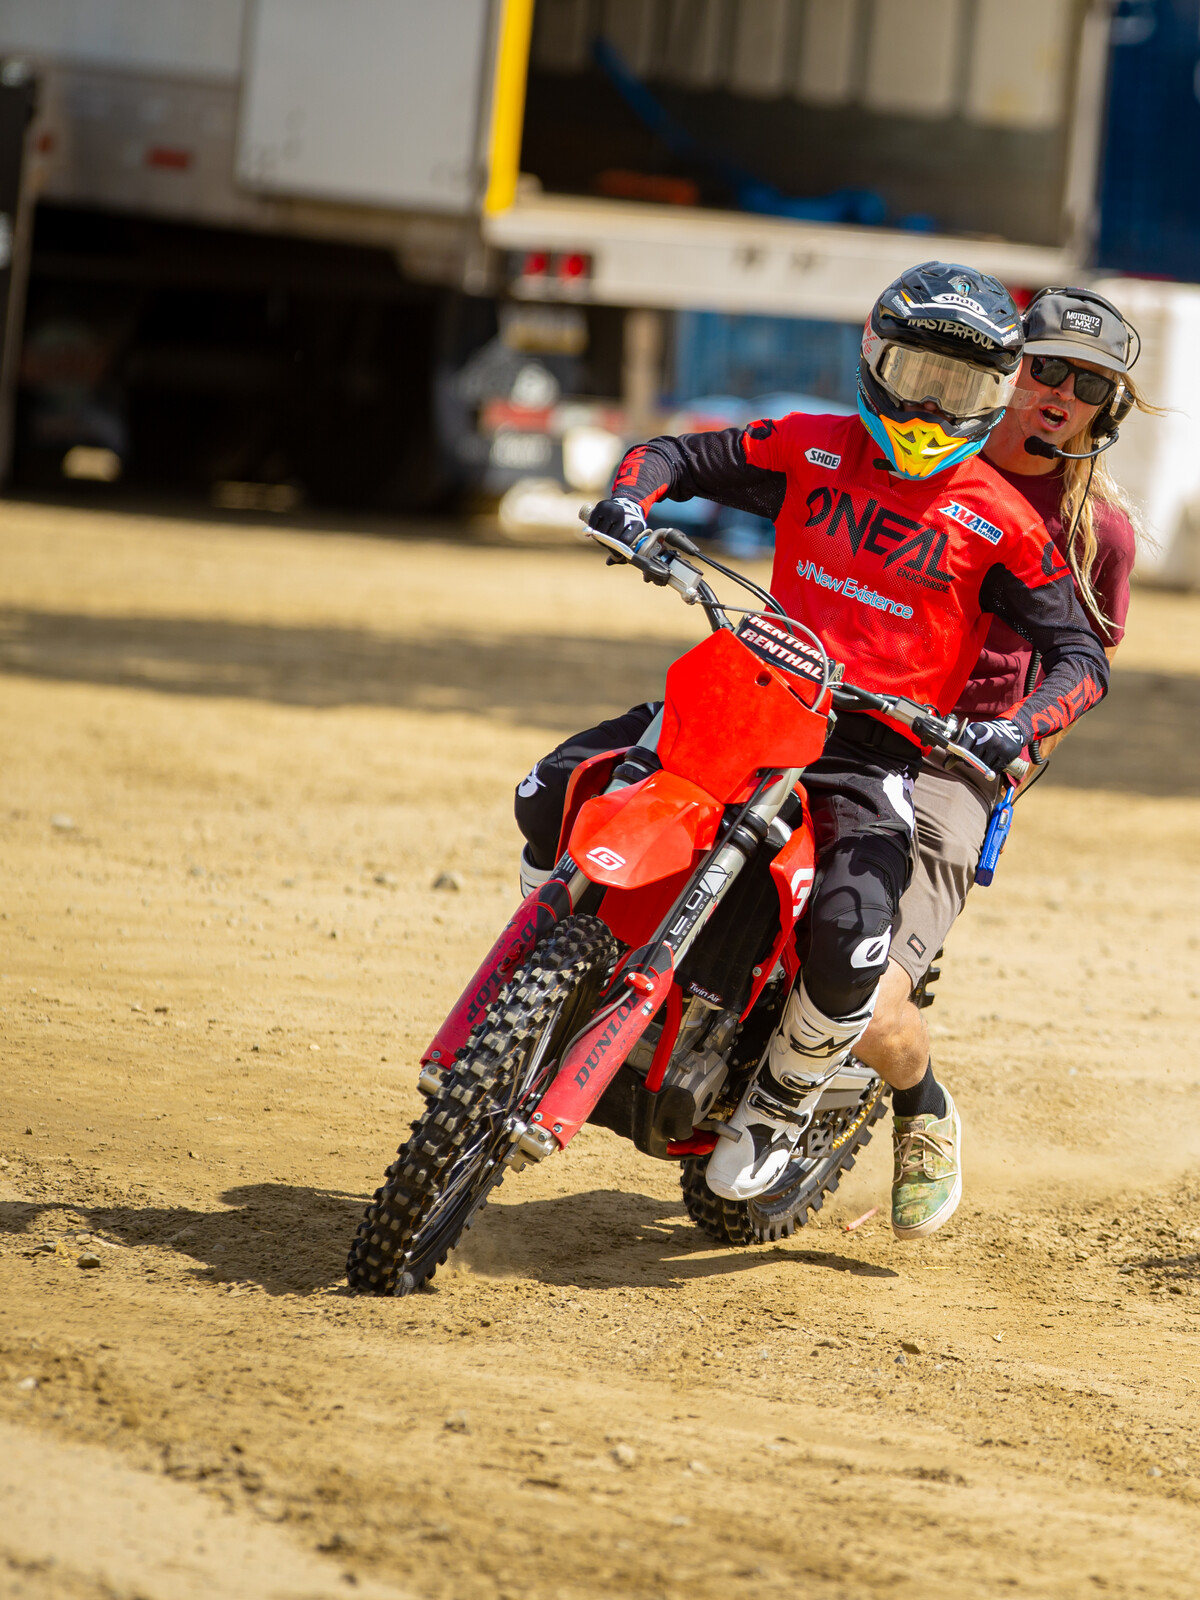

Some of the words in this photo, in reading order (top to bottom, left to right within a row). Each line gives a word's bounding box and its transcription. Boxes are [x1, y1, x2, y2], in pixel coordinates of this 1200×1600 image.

[941, 294, 981, 312] SHOEI
[907, 318, 995, 350] MASTERPOOL
[1075, 319, 1091, 329] MX
[809, 449, 840, 468] SHOE
[943, 504, 982, 531] AMA
[980, 521, 1002, 539] PRO
[977, 528, 998, 544] RACING
[805, 561, 844, 593] New
[841, 576, 914, 620] Existence
[740, 628, 824, 680] RENTHAL
[466, 919, 538, 1023] DLOP
[689, 982, 708, 999] Twin
[706, 990, 722, 1004] Air
